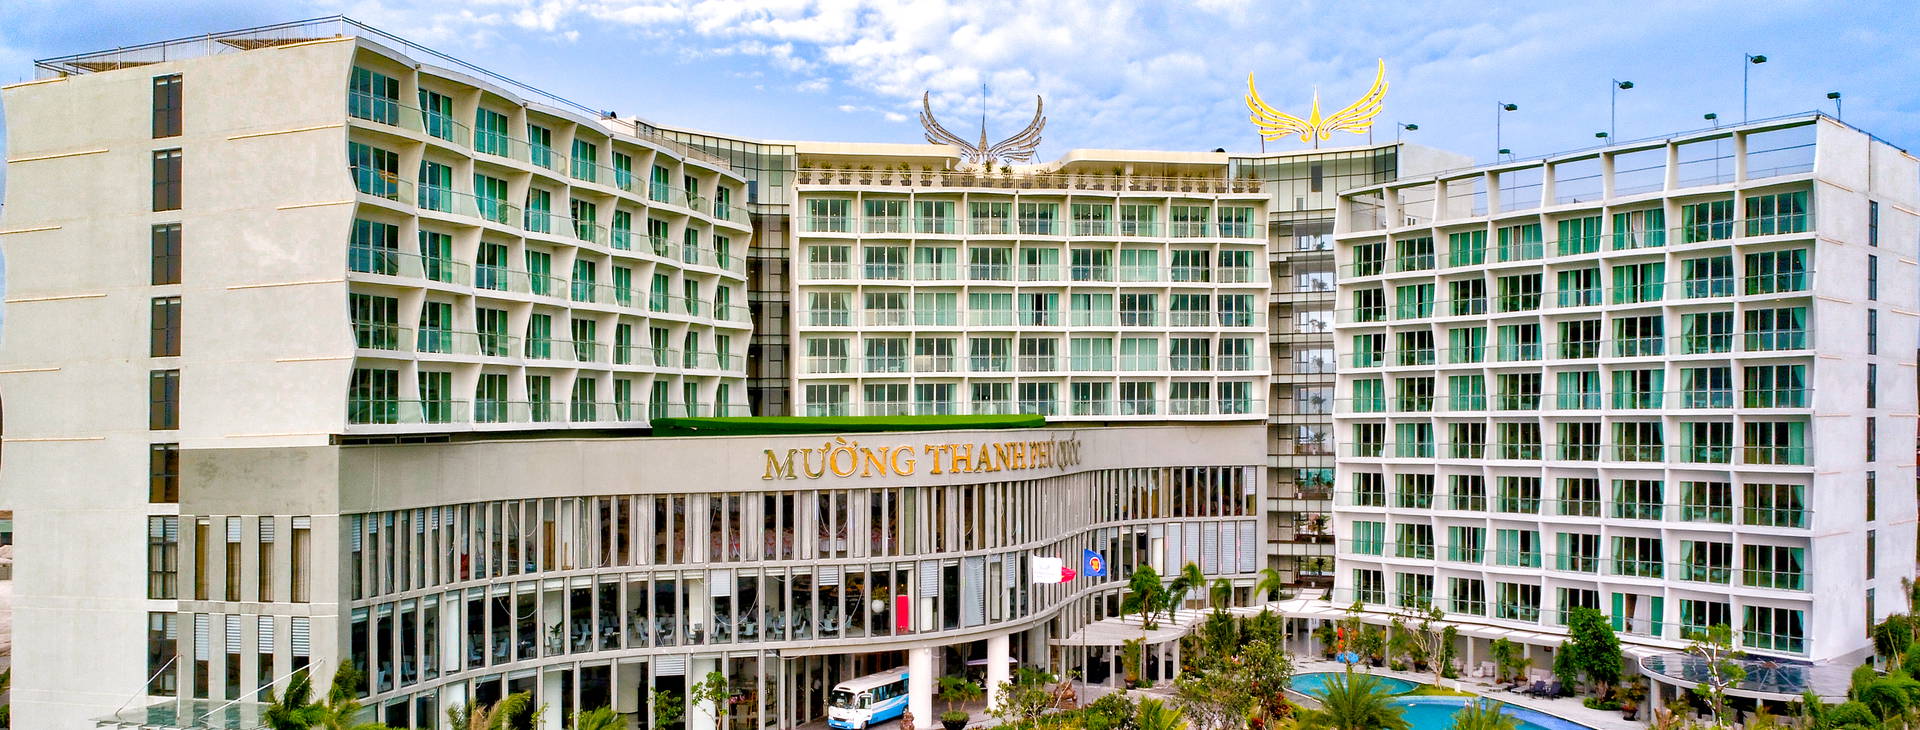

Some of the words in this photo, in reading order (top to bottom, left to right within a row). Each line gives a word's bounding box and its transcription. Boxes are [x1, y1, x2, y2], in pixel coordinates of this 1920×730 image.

[762, 437, 916, 480] MƯỜNG
[925, 442, 1027, 475] THANH
[1029, 432, 1055, 469] PHÚ
